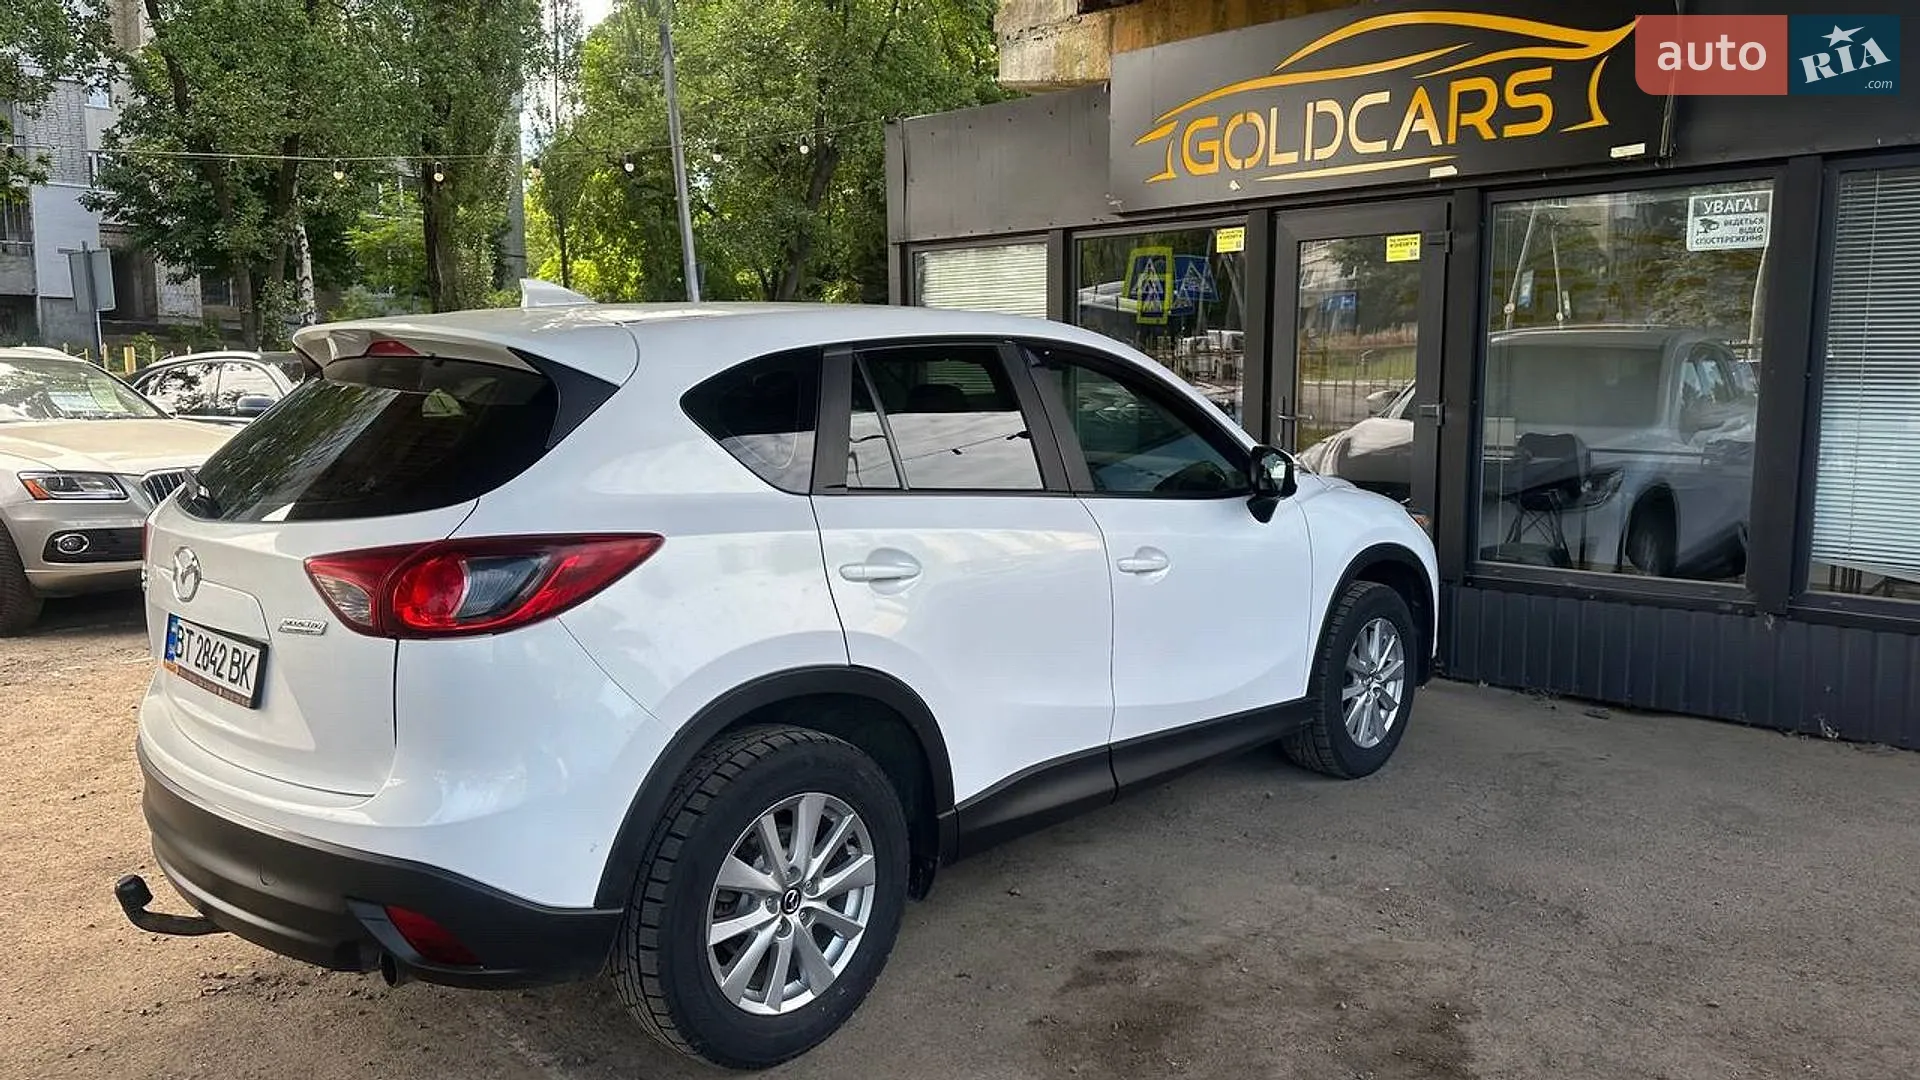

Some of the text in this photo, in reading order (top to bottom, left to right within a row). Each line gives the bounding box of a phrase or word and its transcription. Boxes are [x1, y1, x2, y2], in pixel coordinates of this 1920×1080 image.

[1180, 66, 1554, 176] GOLDCARS
[1703, 198, 1759, 215] УВАГА!
[175, 625, 195, 662] BT
[195, 634, 227, 679] 2842
[228, 647, 256, 690] BK
